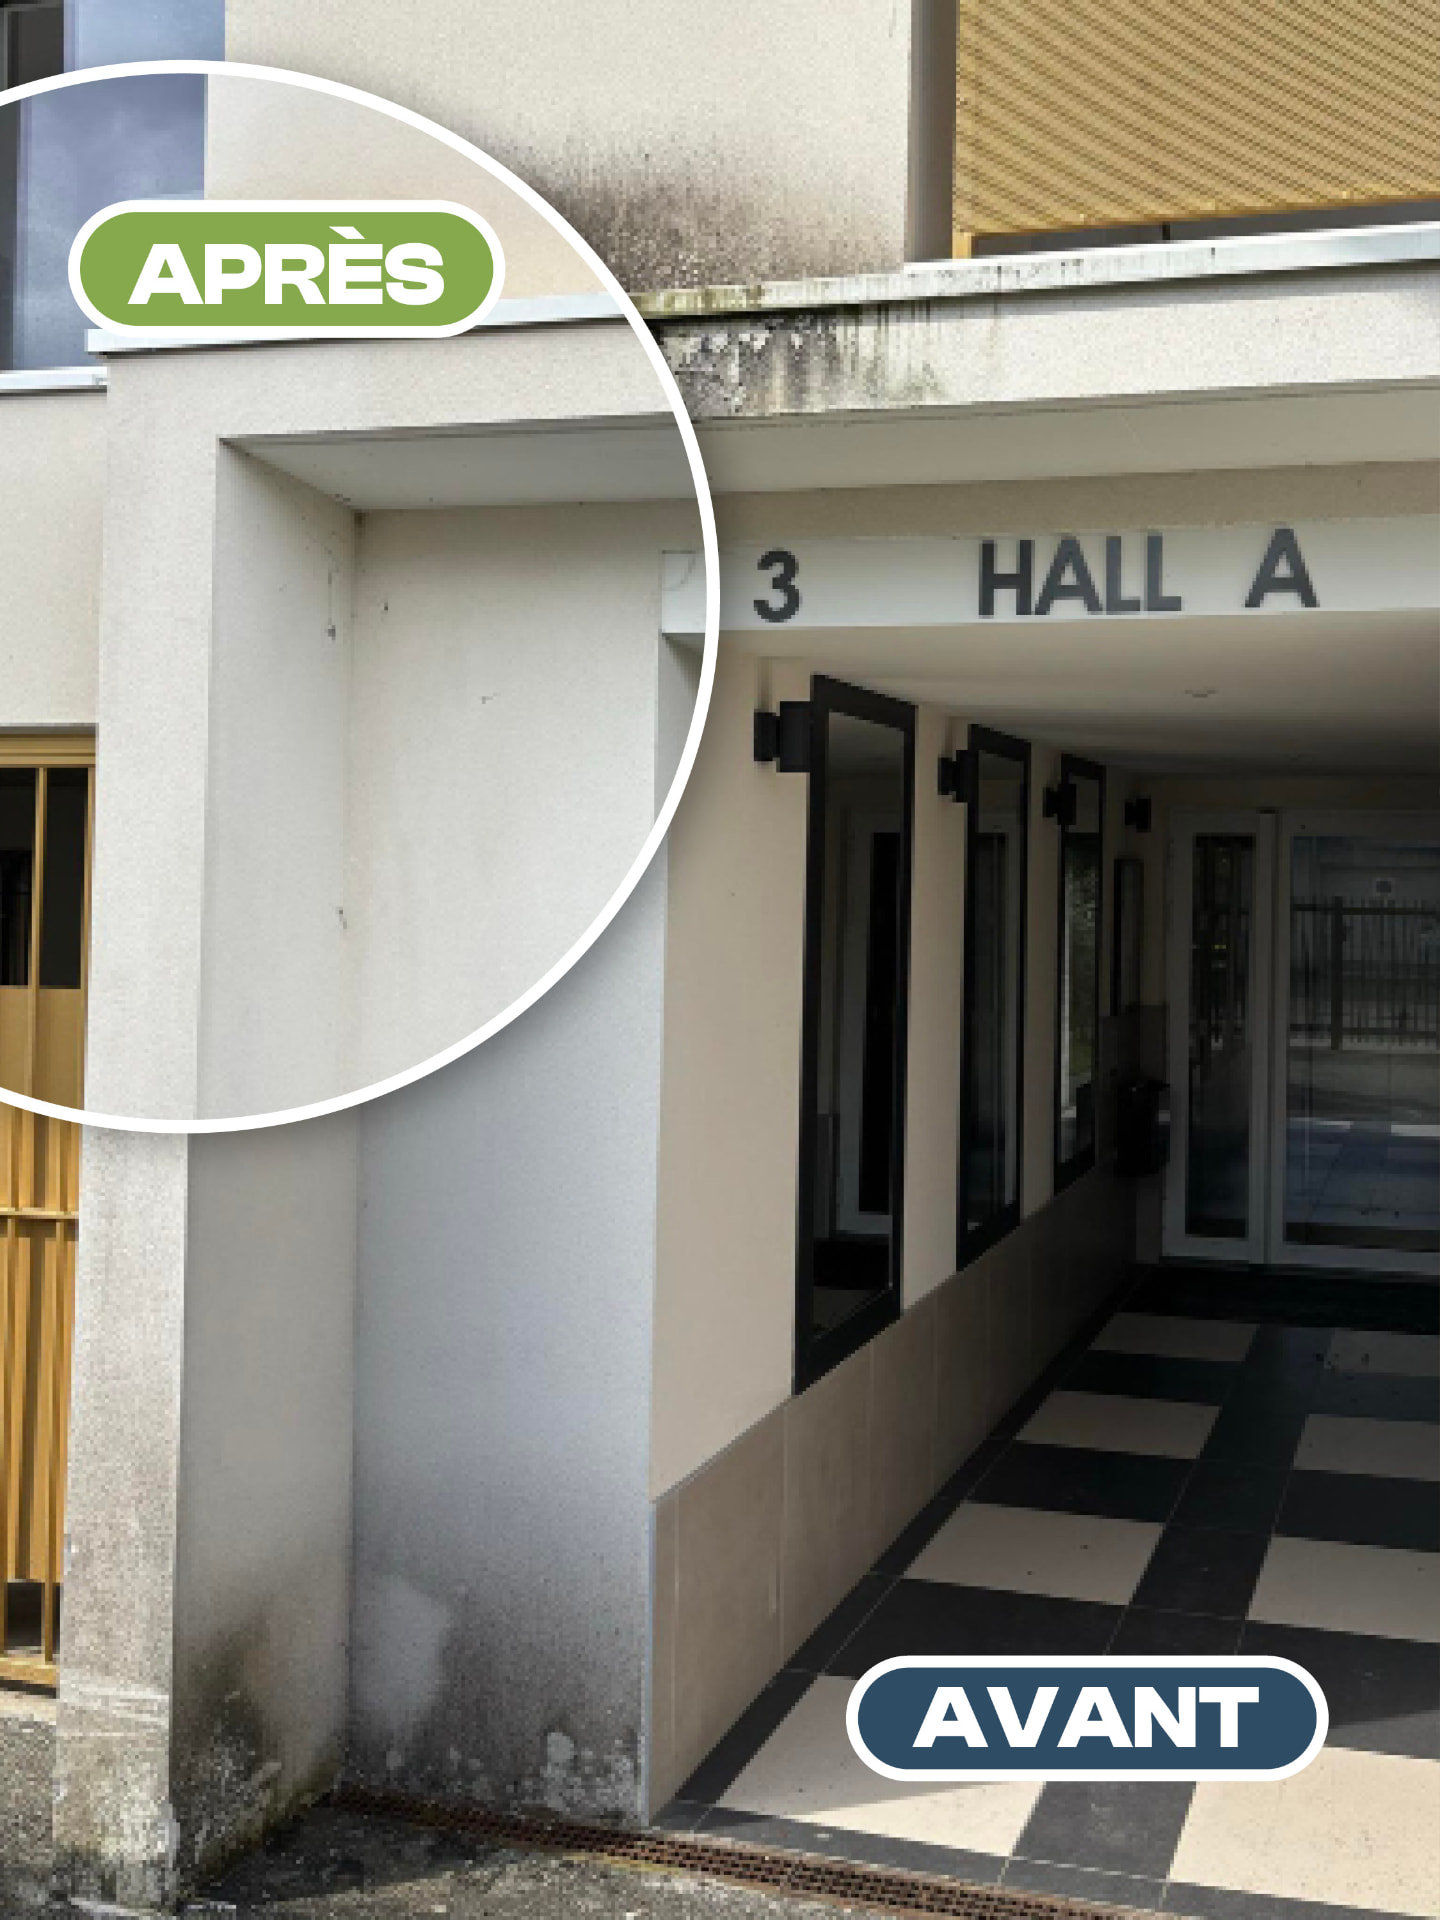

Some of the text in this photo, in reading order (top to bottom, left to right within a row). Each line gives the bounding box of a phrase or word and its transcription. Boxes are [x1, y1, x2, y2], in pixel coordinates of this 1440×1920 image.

[753, 526, 1319, 623] 3 HALL A
